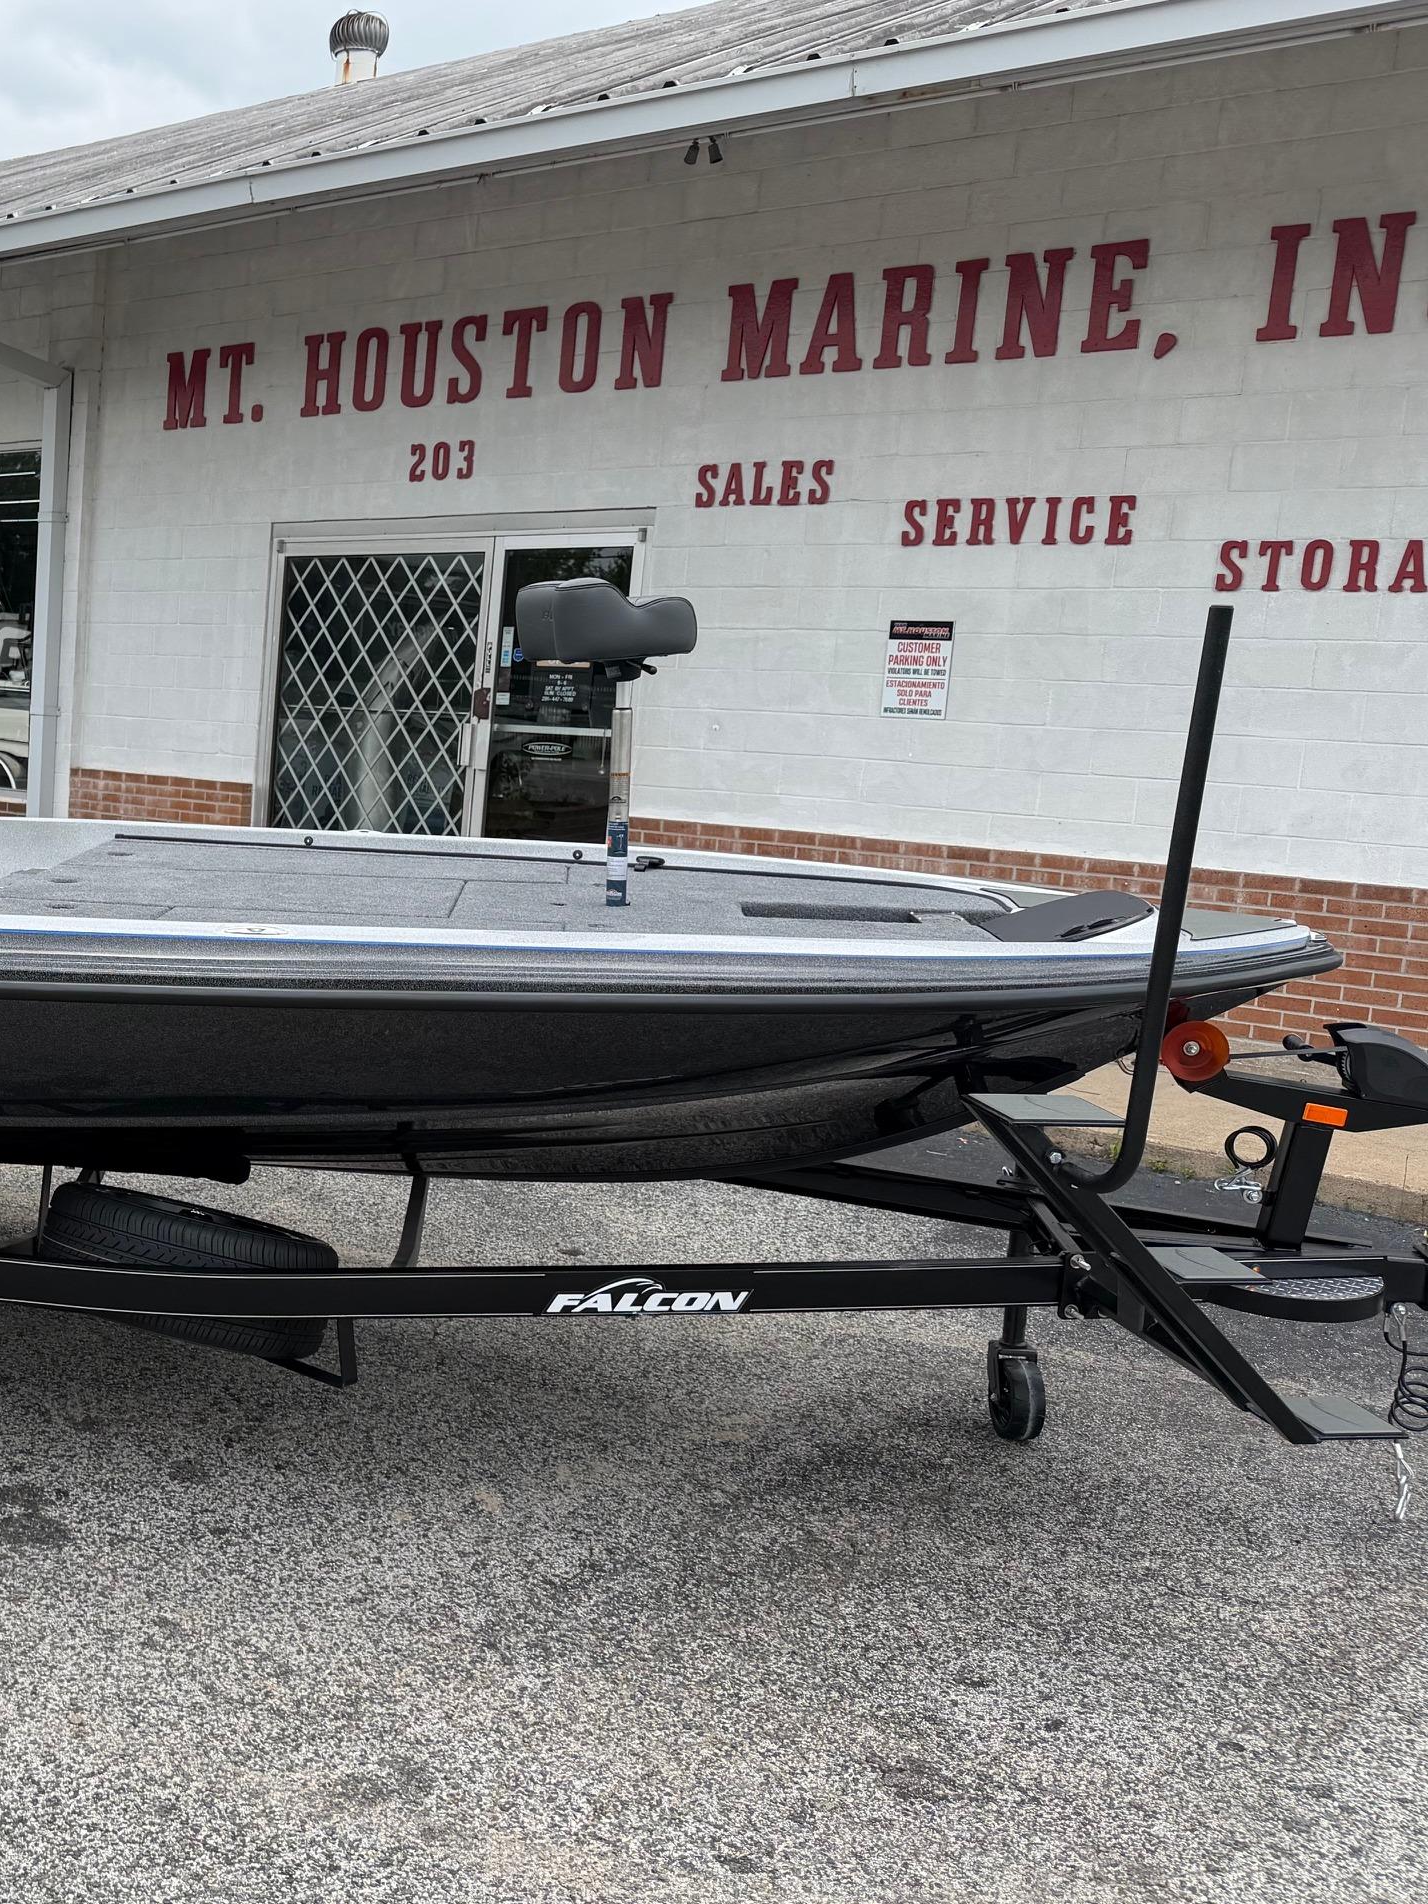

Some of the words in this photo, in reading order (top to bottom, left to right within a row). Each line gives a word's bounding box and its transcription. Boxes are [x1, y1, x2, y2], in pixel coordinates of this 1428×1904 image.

[163, 342, 264, 430] MT.
[299, 292, 674, 418] HOUSTON
[721, 238, 1178, 382] MARINE,
[1256, 211, 1428, 341] IN
[408, 439, 476, 482] 203
[694, 459, 835, 508] SALES
[901, 495, 1137, 547] SERVICE
[1214, 539, 1428, 593] STORA
[897, 641, 941, 653] CUSTOMER
[888, 654, 924, 666] PARKING
[926, 655, 948, 667] ONLY
[886, 680, 945, 689] ESTACIONAMIENTO
[897, 689, 913, 697] SOLO
[898, 698, 928, 706] CLIENTES
[546, 1291, 750, 1313] FALCON
